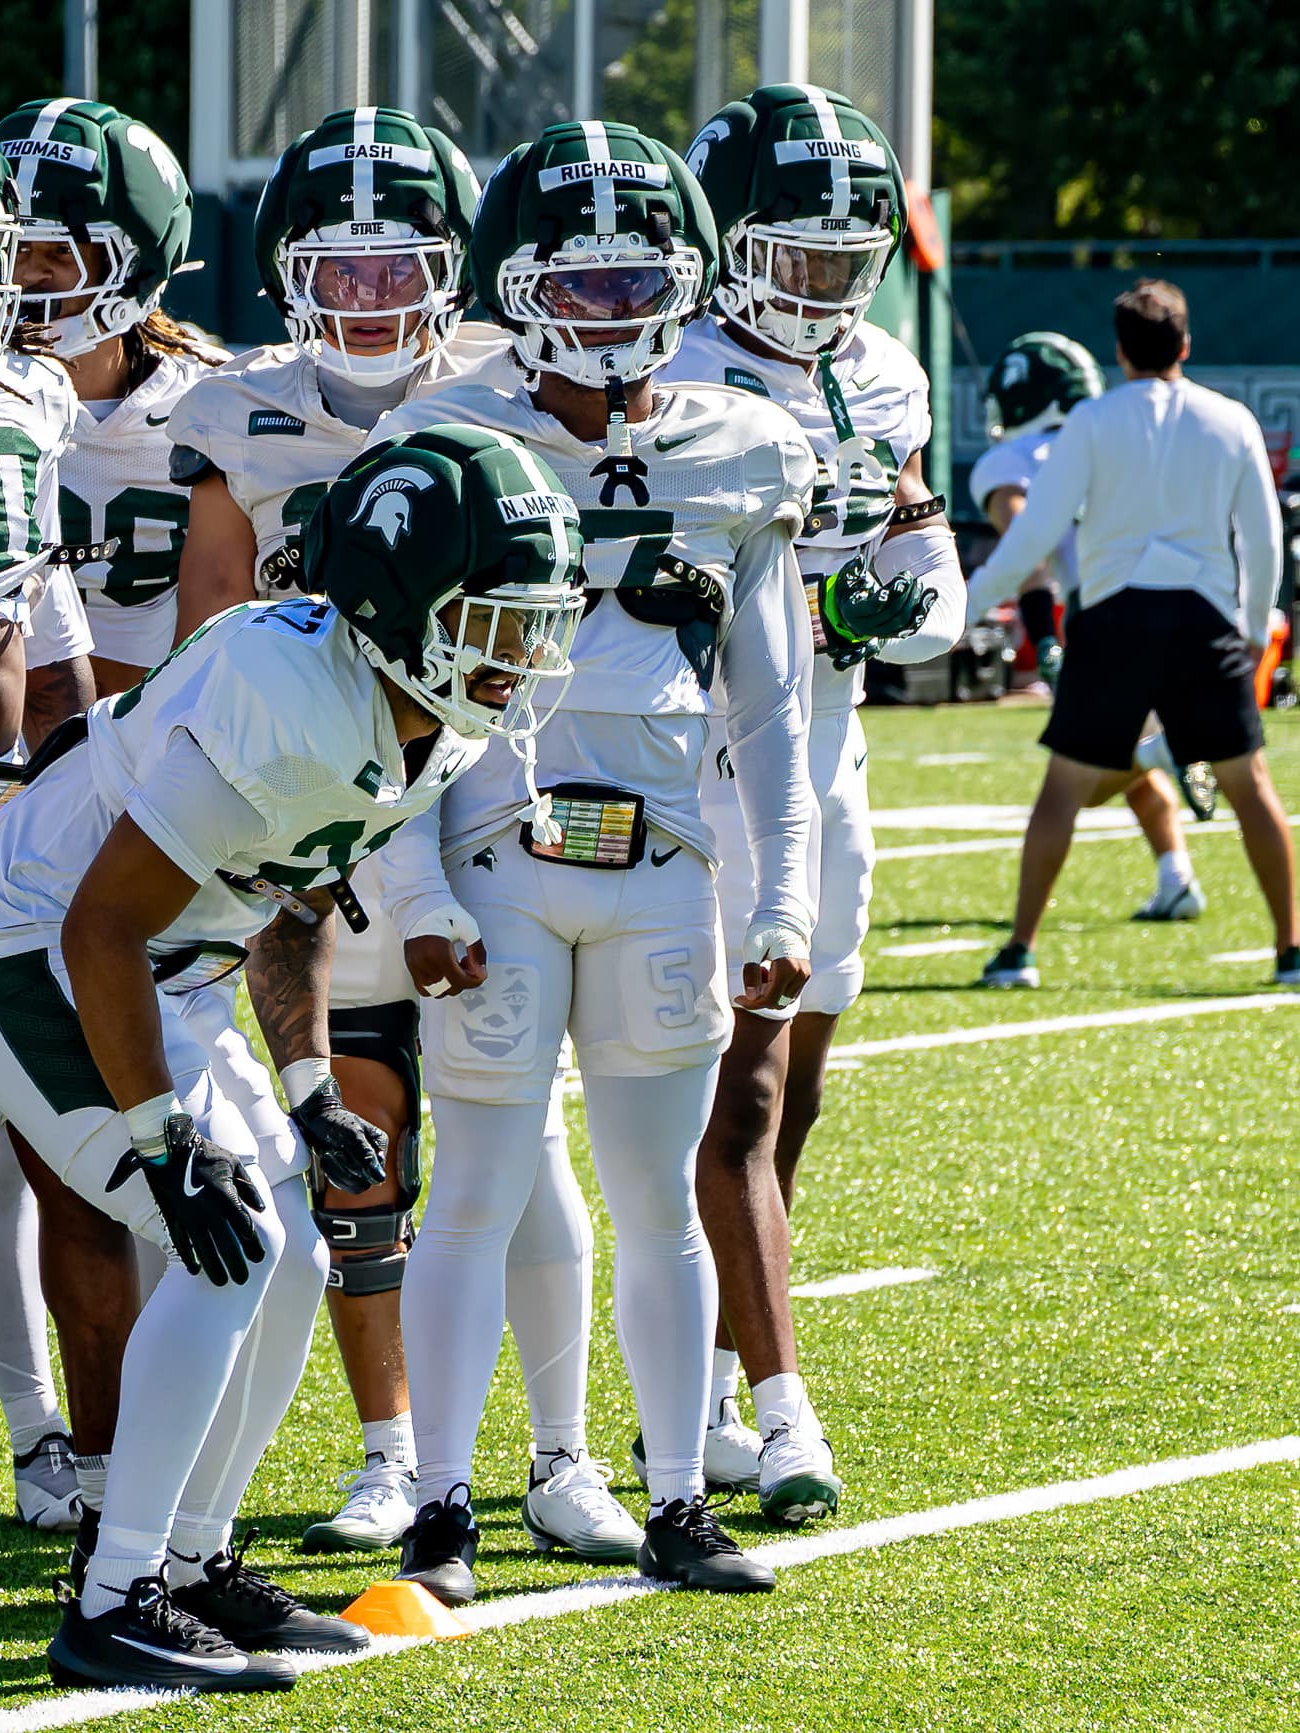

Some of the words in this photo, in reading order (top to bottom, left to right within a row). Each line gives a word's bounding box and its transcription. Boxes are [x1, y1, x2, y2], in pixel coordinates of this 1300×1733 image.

[2, 141, 73, 161] THOMAS
[344, 145, 392, 160] GASH
[805, 141, 861, 158] YOUNG
[561, 163, 645, 182] RICHARD
[350, 221, 385, 236] STATE
[821, 218, 851, 231] STATE
[500, 499, 524, 520] N.
[647, 946, 698, 1030] 5
